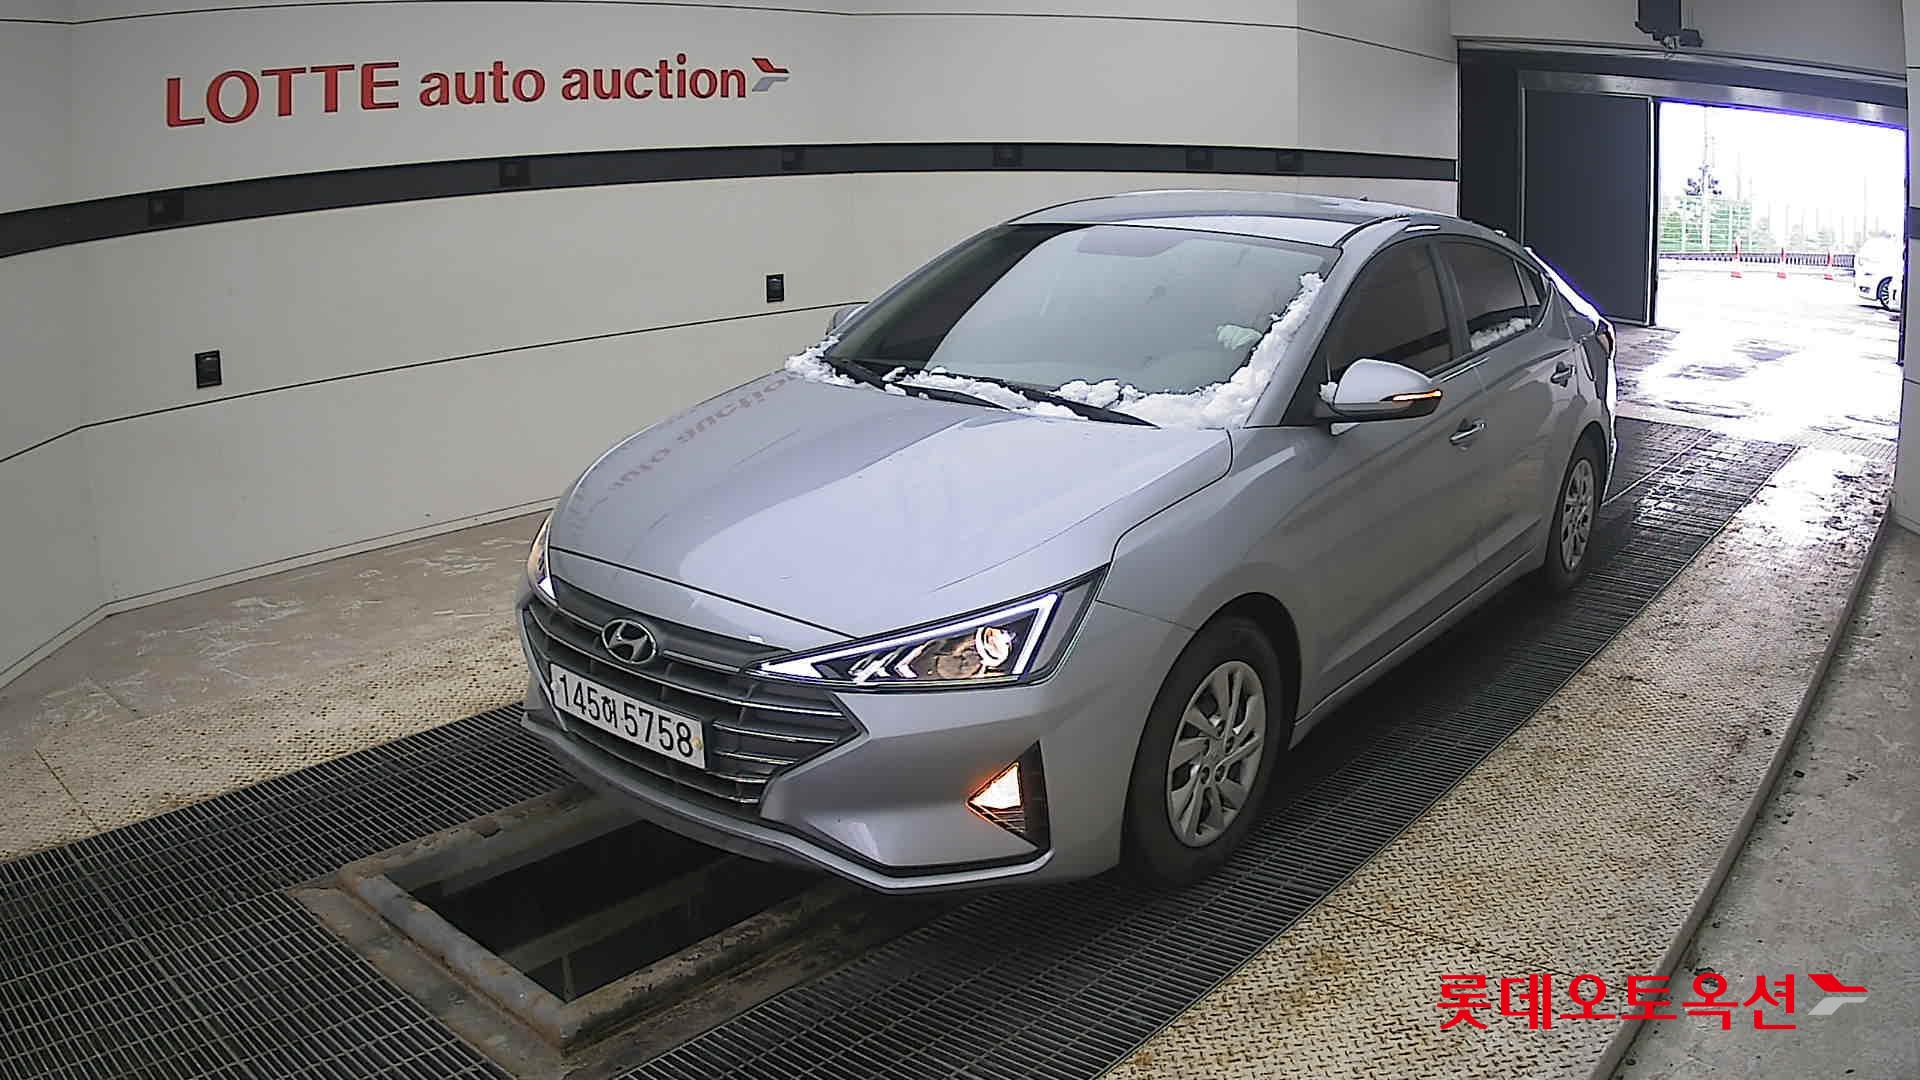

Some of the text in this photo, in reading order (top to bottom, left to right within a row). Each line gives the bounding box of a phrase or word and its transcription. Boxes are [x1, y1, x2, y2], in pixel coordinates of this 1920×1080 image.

[165, 53, 748, 127] LOTTE auto auction
[623, 701, 694, 758] 5758
